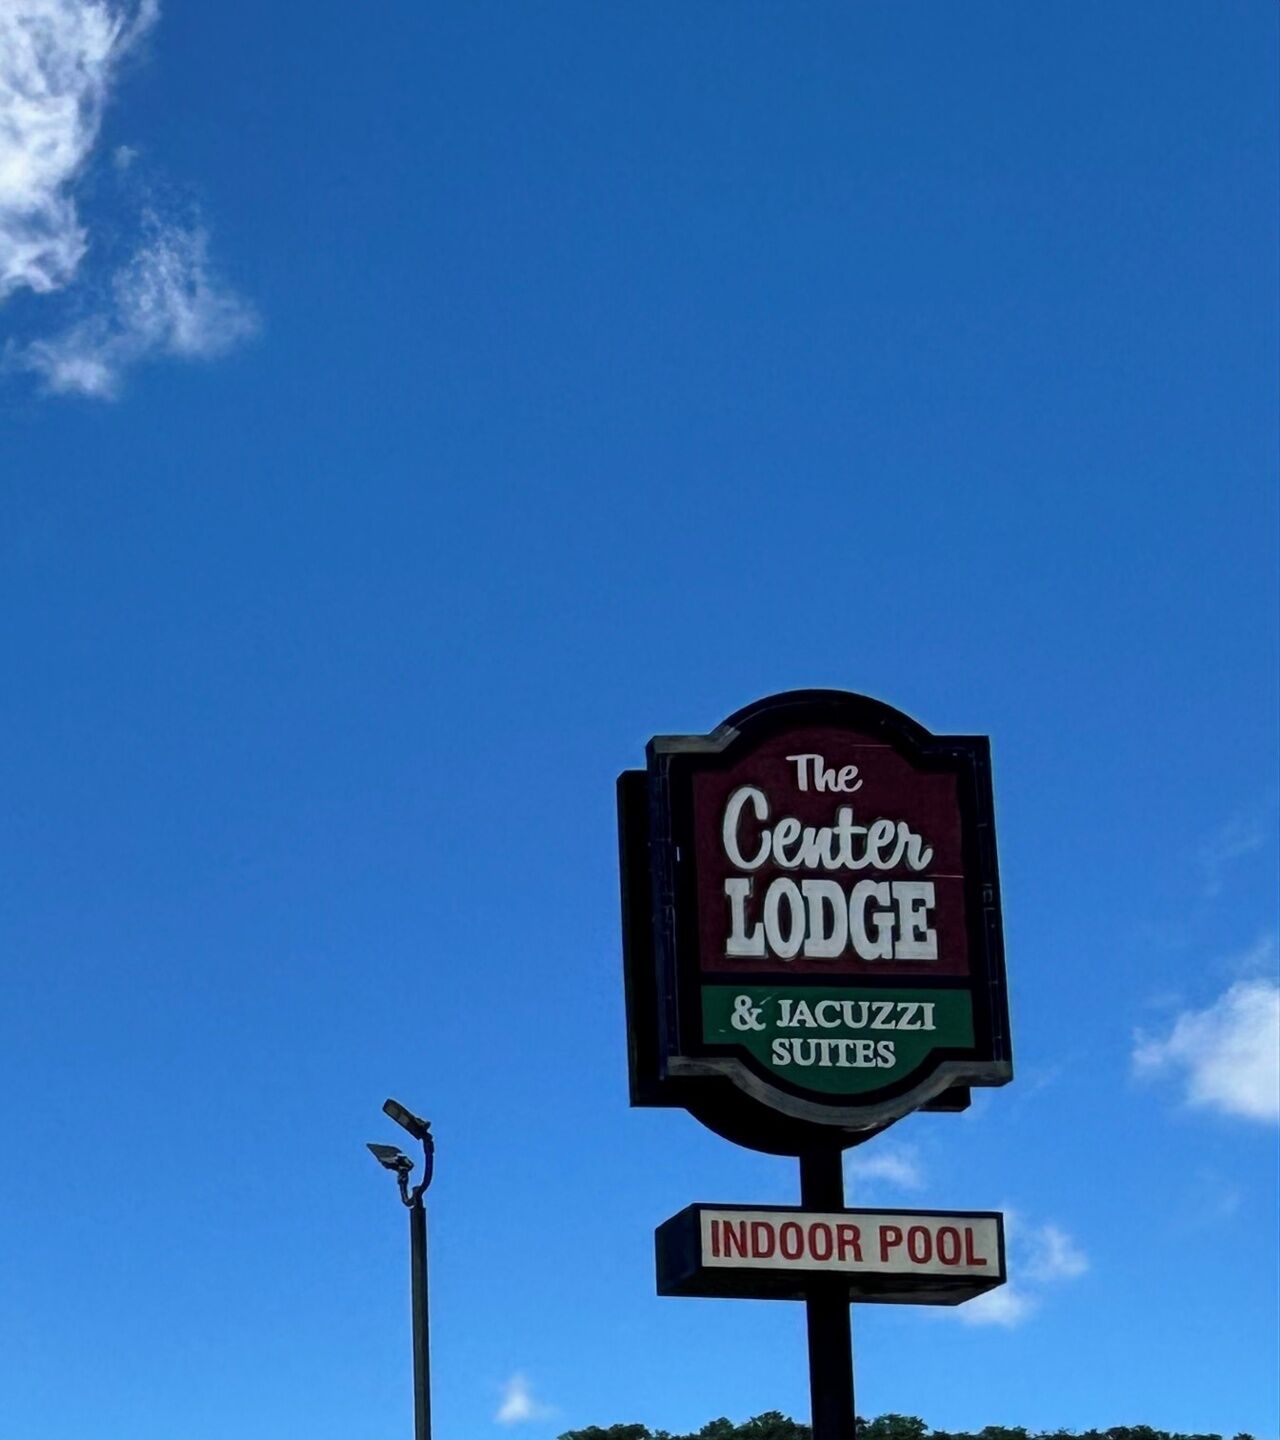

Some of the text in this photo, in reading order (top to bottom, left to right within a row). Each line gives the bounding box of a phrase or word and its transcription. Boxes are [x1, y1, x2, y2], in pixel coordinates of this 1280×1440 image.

[786, 754, 863, 792] The
[722, 786, 934, 871] Center
[724, 877, 938, 961] LODGE
[730, 995, 937, 1031] & JACUZZI
[771, 1037, 897, 1069] SUITES
[710, 1219, 988, 1266] INDOOR POOL
